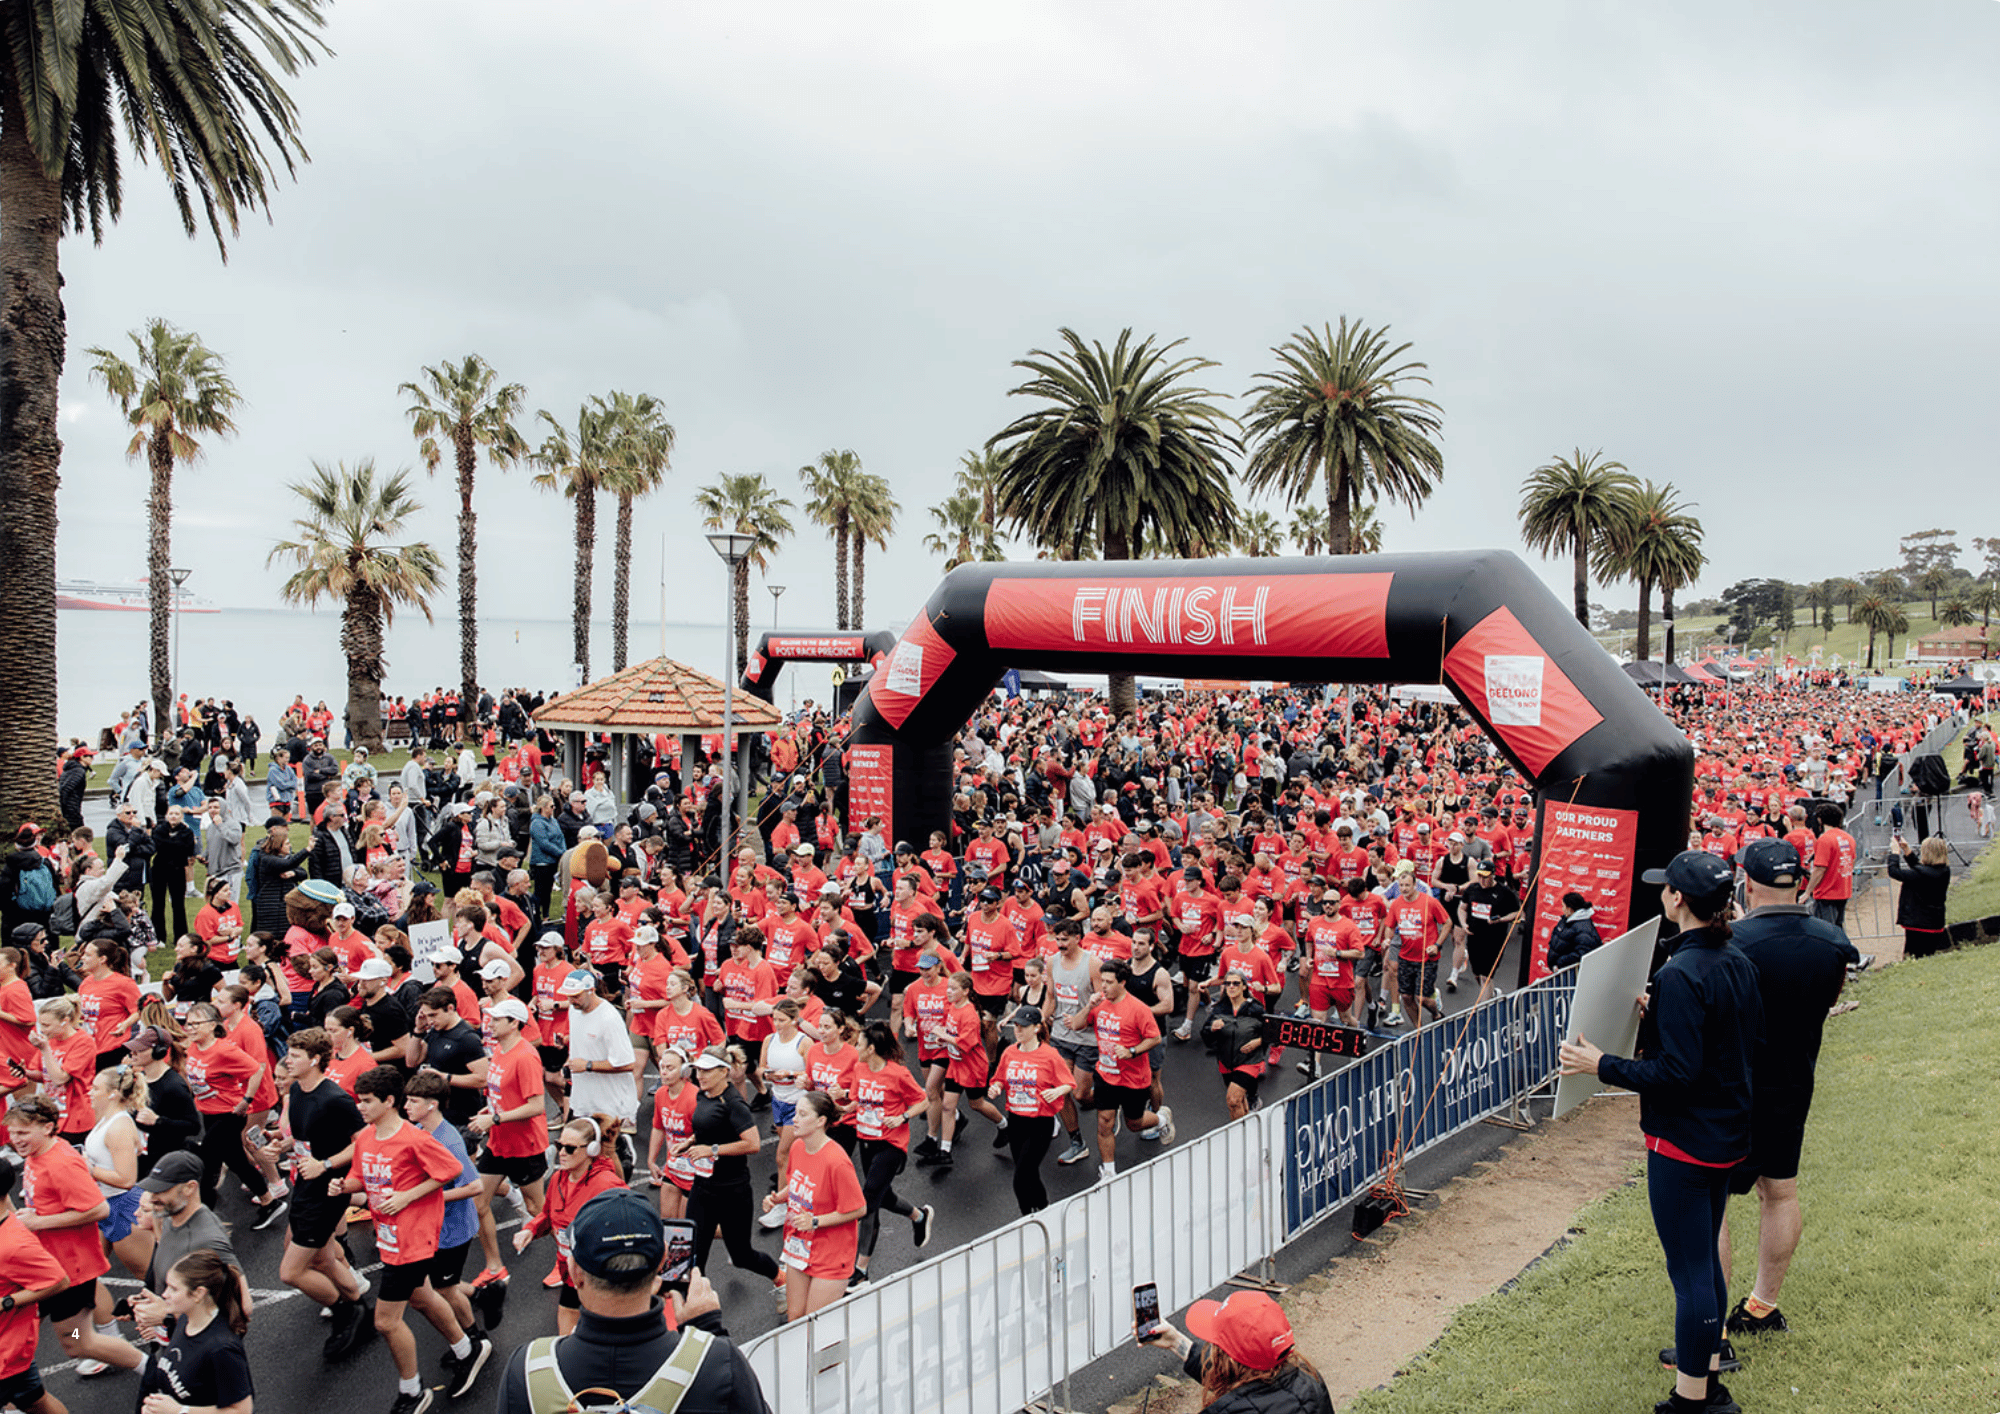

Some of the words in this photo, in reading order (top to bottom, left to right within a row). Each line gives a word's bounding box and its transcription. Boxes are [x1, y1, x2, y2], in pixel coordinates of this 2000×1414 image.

[1073, 586, 1270, 645] FINISH
[775, 646, 795, 656] POST
[796, 646, 816, 656] RACE
[818, 646, 857, 656] PRECINCT
[1489, 688, 1538, 699] GEELONG
[1555, 811, 1576, 823] OUR
[1577, 814, 1618, 828] PROUD
[1556, 826, 1614, 843] PARTNERS
[917, 1001, 944, 1010] RUN4
[812, 1069, 838, 1084] RUN4
[1006, 1068, 1037, 1081] RUN4
[362, 1162, 393, 1179] RUN4
[789, 1178, 813, 1204] RUN4
